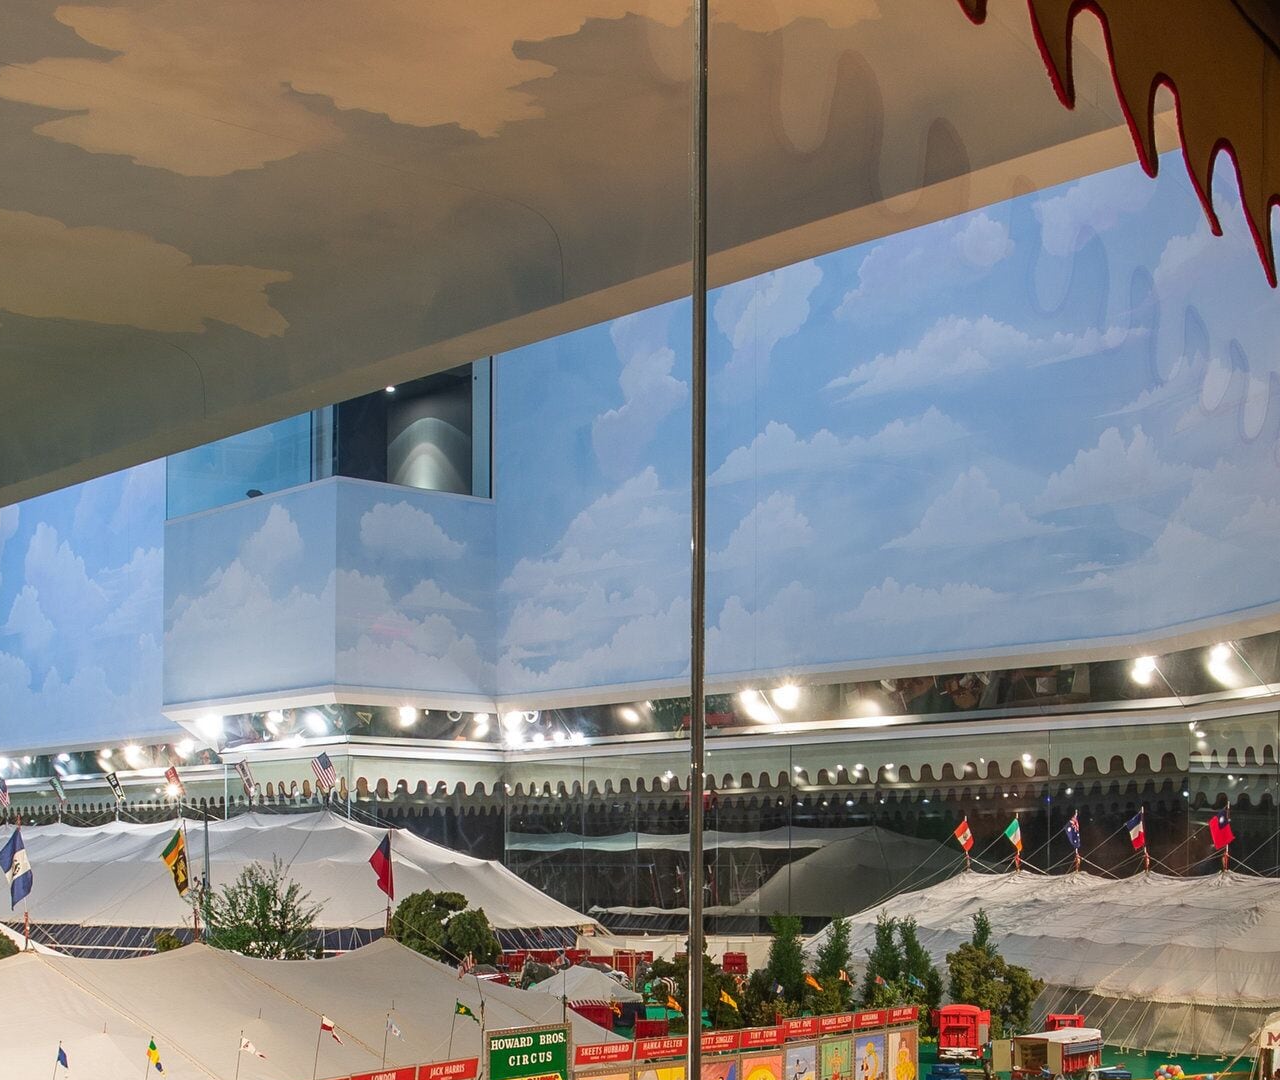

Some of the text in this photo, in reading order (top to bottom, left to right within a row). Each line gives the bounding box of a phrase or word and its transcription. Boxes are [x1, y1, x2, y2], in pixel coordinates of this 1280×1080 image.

[491, 1032, 566, 1050] HOWARD BROS.
[603, 1043, 629, 1055] HUBBARD
[508, 1051, 553, 1067] CIRCUS
[429, 1063, 465, 1079] JACK HARRIS
